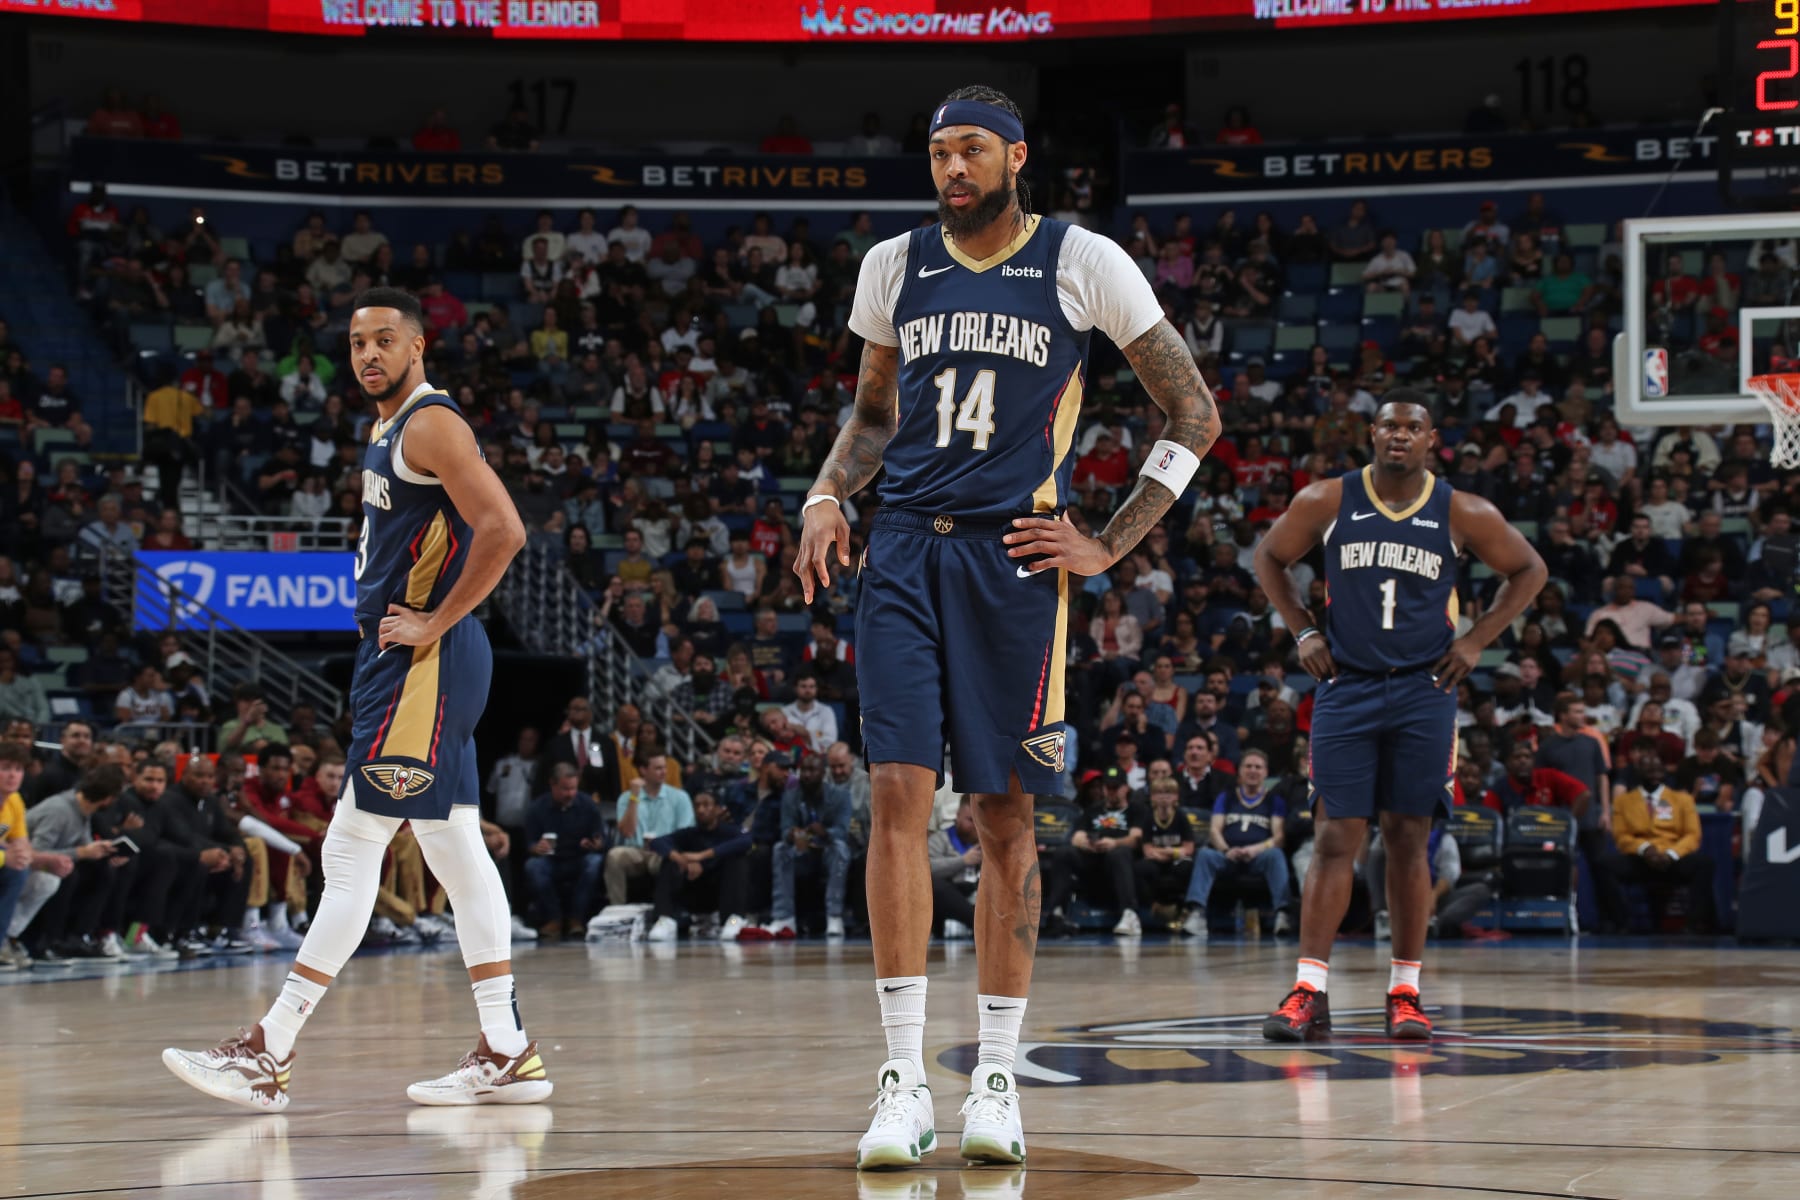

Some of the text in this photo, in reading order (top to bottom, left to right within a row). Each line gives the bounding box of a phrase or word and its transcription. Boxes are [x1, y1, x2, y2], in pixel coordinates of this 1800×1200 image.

[321, 0, 599, 28] WELCOME TO THE BLENDER
[1514, 54, 1590, 112] 118
[275, 159, 504, 184] BETRIVERS
[642, 165, 867, 187] BETRIVERS
[1263, 147, 1493, 177] BETRIVERS
[1001, 265, 1043, 278] ibotta
[899, 311, 1051, 368] NEW ORLEANS
[934, 367, 997, 451] 14
[1340, 541, 1442, 580] NEW ORLEANS
[1379, 578, 1396, 630] 1
